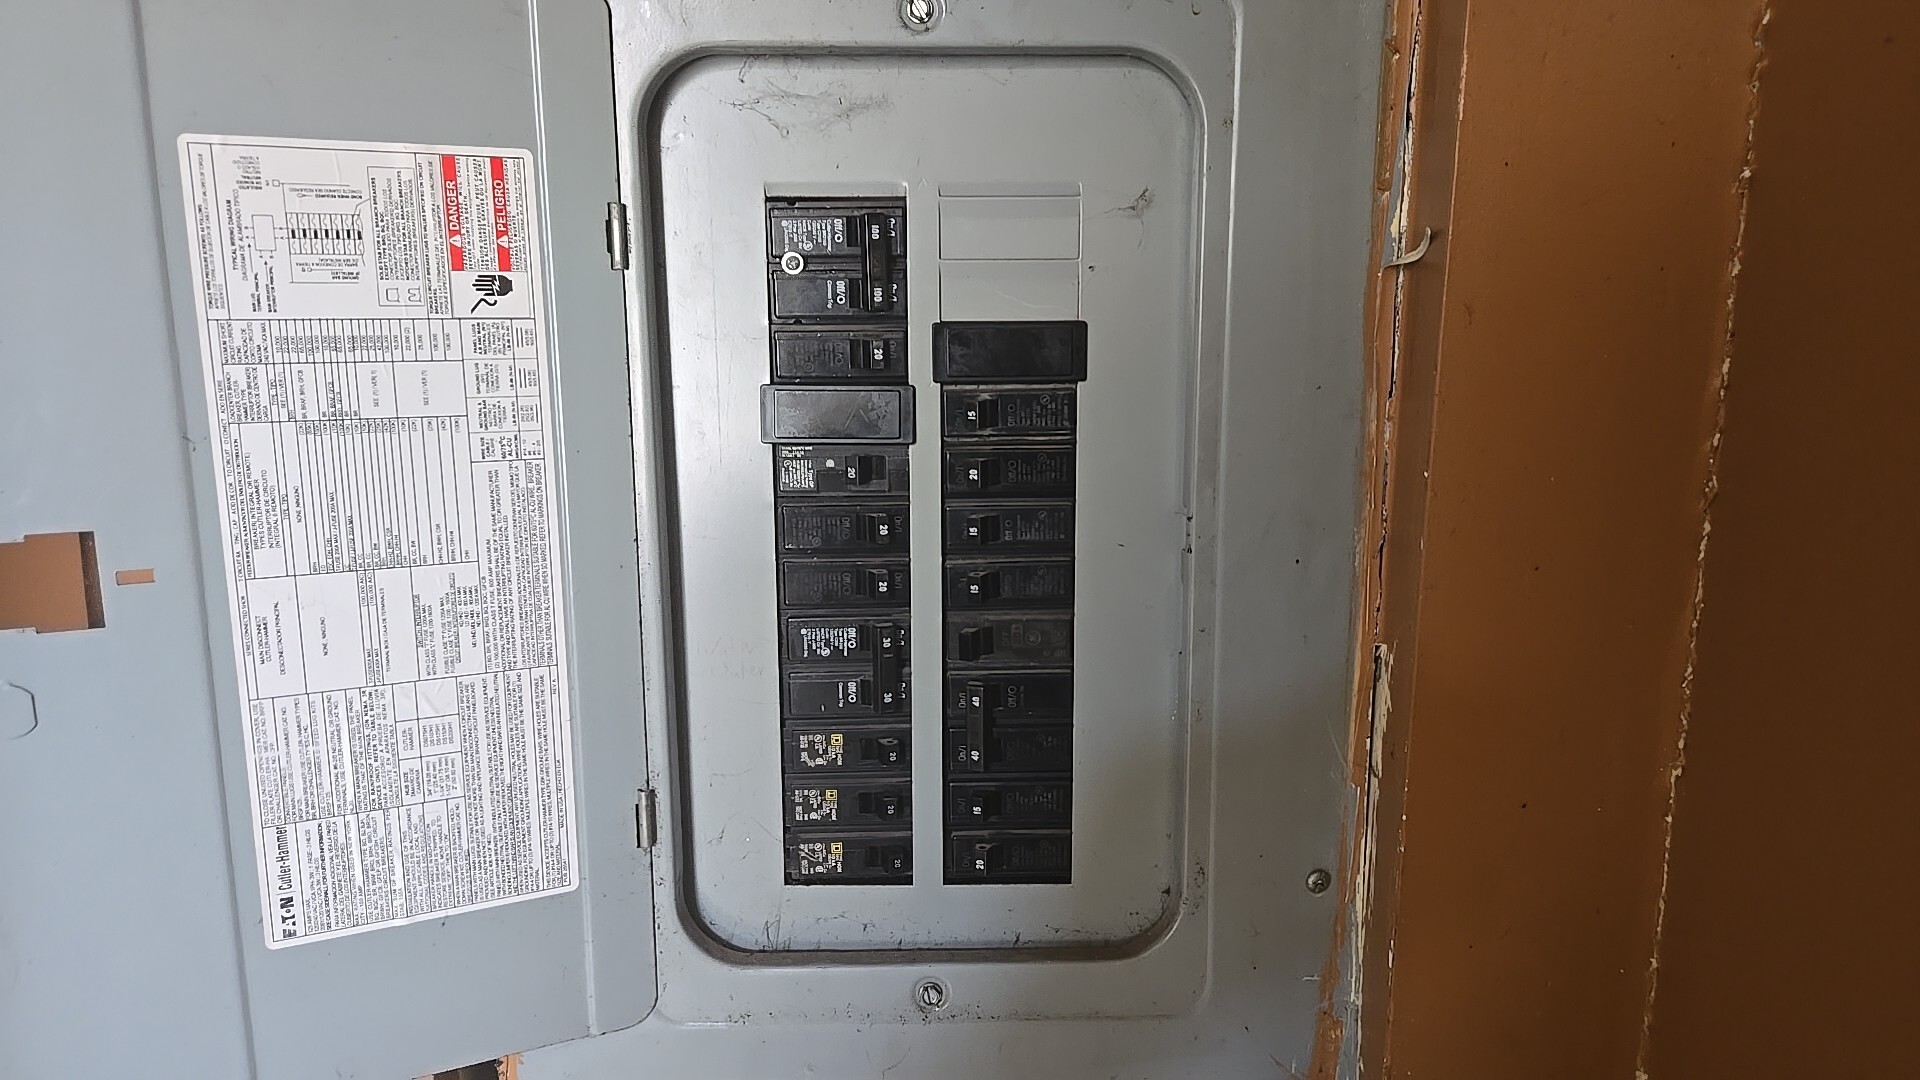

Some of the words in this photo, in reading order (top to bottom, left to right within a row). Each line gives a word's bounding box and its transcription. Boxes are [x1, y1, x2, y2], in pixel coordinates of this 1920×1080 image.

[445, 180, 460, 229] DANGER
[493, 179, 507, 230] PELIGRO
[225, 198, 234, 225] DIAGRAM
[228, 225, 236, 246] WIRING
[871, 224, 879, 239] 100
[230, 247, 238, 270] TYPICAL
[874, 287, 882, 302] 100
[221, 339, 229, 363] MAXIMUM
[874, 349, 883, 360] 20
[227, 391, 236, 422] LOADCENTER
[968, 411, 976, 420] 15
[847, 467, 855, 478] 20
[969, 469, 978, 480] 20
[260, 468, 269, 497] CIRCUITO
[253, 478, 264, 529] CUTLER-HAMMER
[263, 497, 270, 507] DE
[264, 507, 274, 548] INTERRUPTOR
[879, 525, 888, 535] 20
[969, 527, 978, 535] 15
[258, 529, 266, 548] TYPES
[879, 582, 887, 592] 20
[970, 585, 978, 593] 15
[272, 601, 281, 627] PRINCIPAL
[255, 614, 263, 649] DISCONNECT
[261, 616, 271, 662] CUTLER-HAMMER
[883, 637, 891, 648] 30
[275, 627, 286, 675] DESCONECTADOR
[884, 693, 892, 703] 30
[972, 697, 979, 707] 40
[889, 752, 896, 761] 20
[971, 751, 979, 760] 40
[887, 806, 894, 814] 20
[973, 807, 981, 815] 15
[272, 825, 293, 890] Cutler-Hammer
[894, 859, 901, 868] 20
[976, 860, 984, 869] 20
